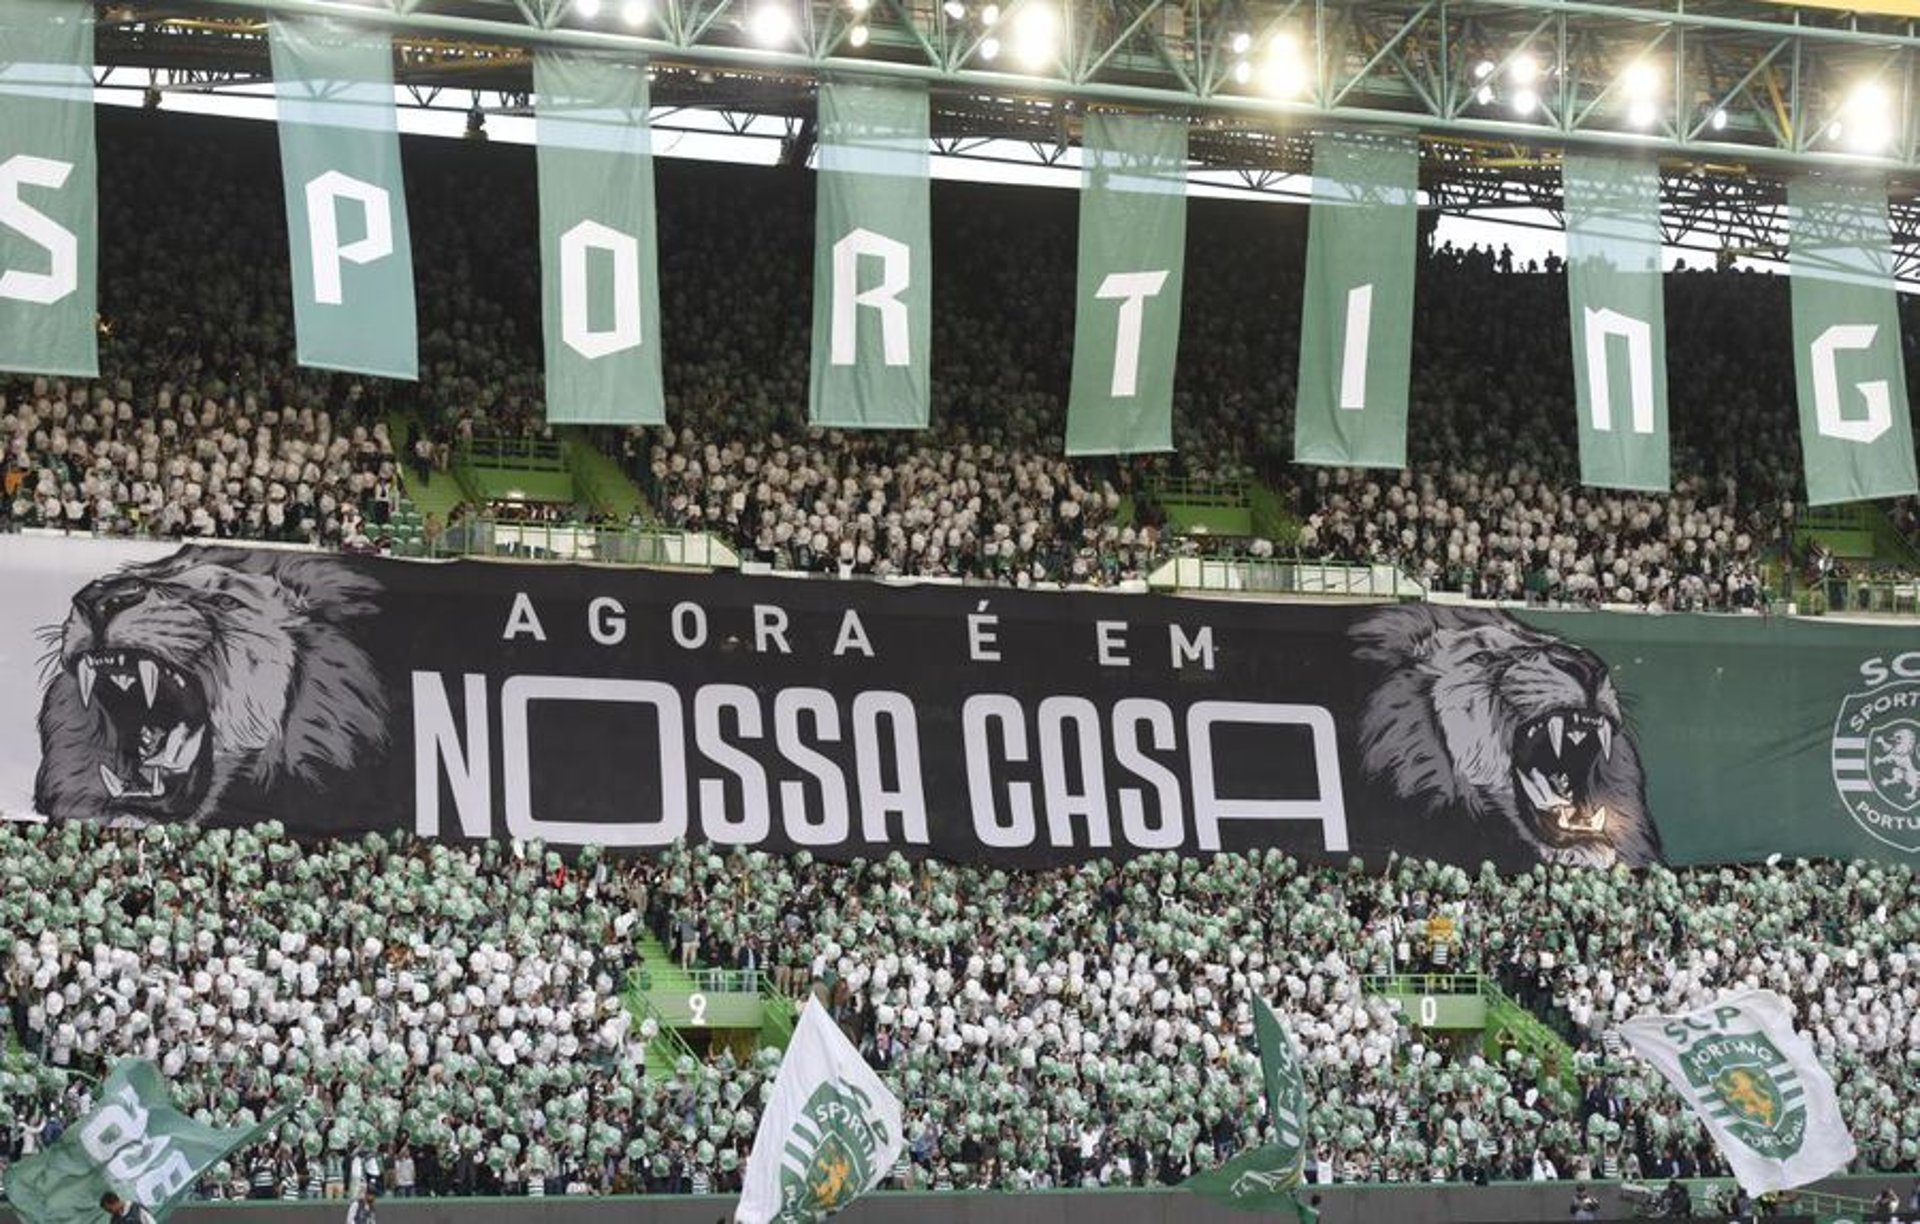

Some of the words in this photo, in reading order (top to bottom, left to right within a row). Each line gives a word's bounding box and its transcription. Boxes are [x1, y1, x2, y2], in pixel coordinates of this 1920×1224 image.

[969, 600, 1000, 661] É
[1098, 621, 1214, 669] EM
[413, 671, 930, 847] NOSSA
[963, 695, 1349, 852] CASA
[1664, 1006, 1741, 1044] SCP
[1690, 1039, 1773, 1077] ORTING
